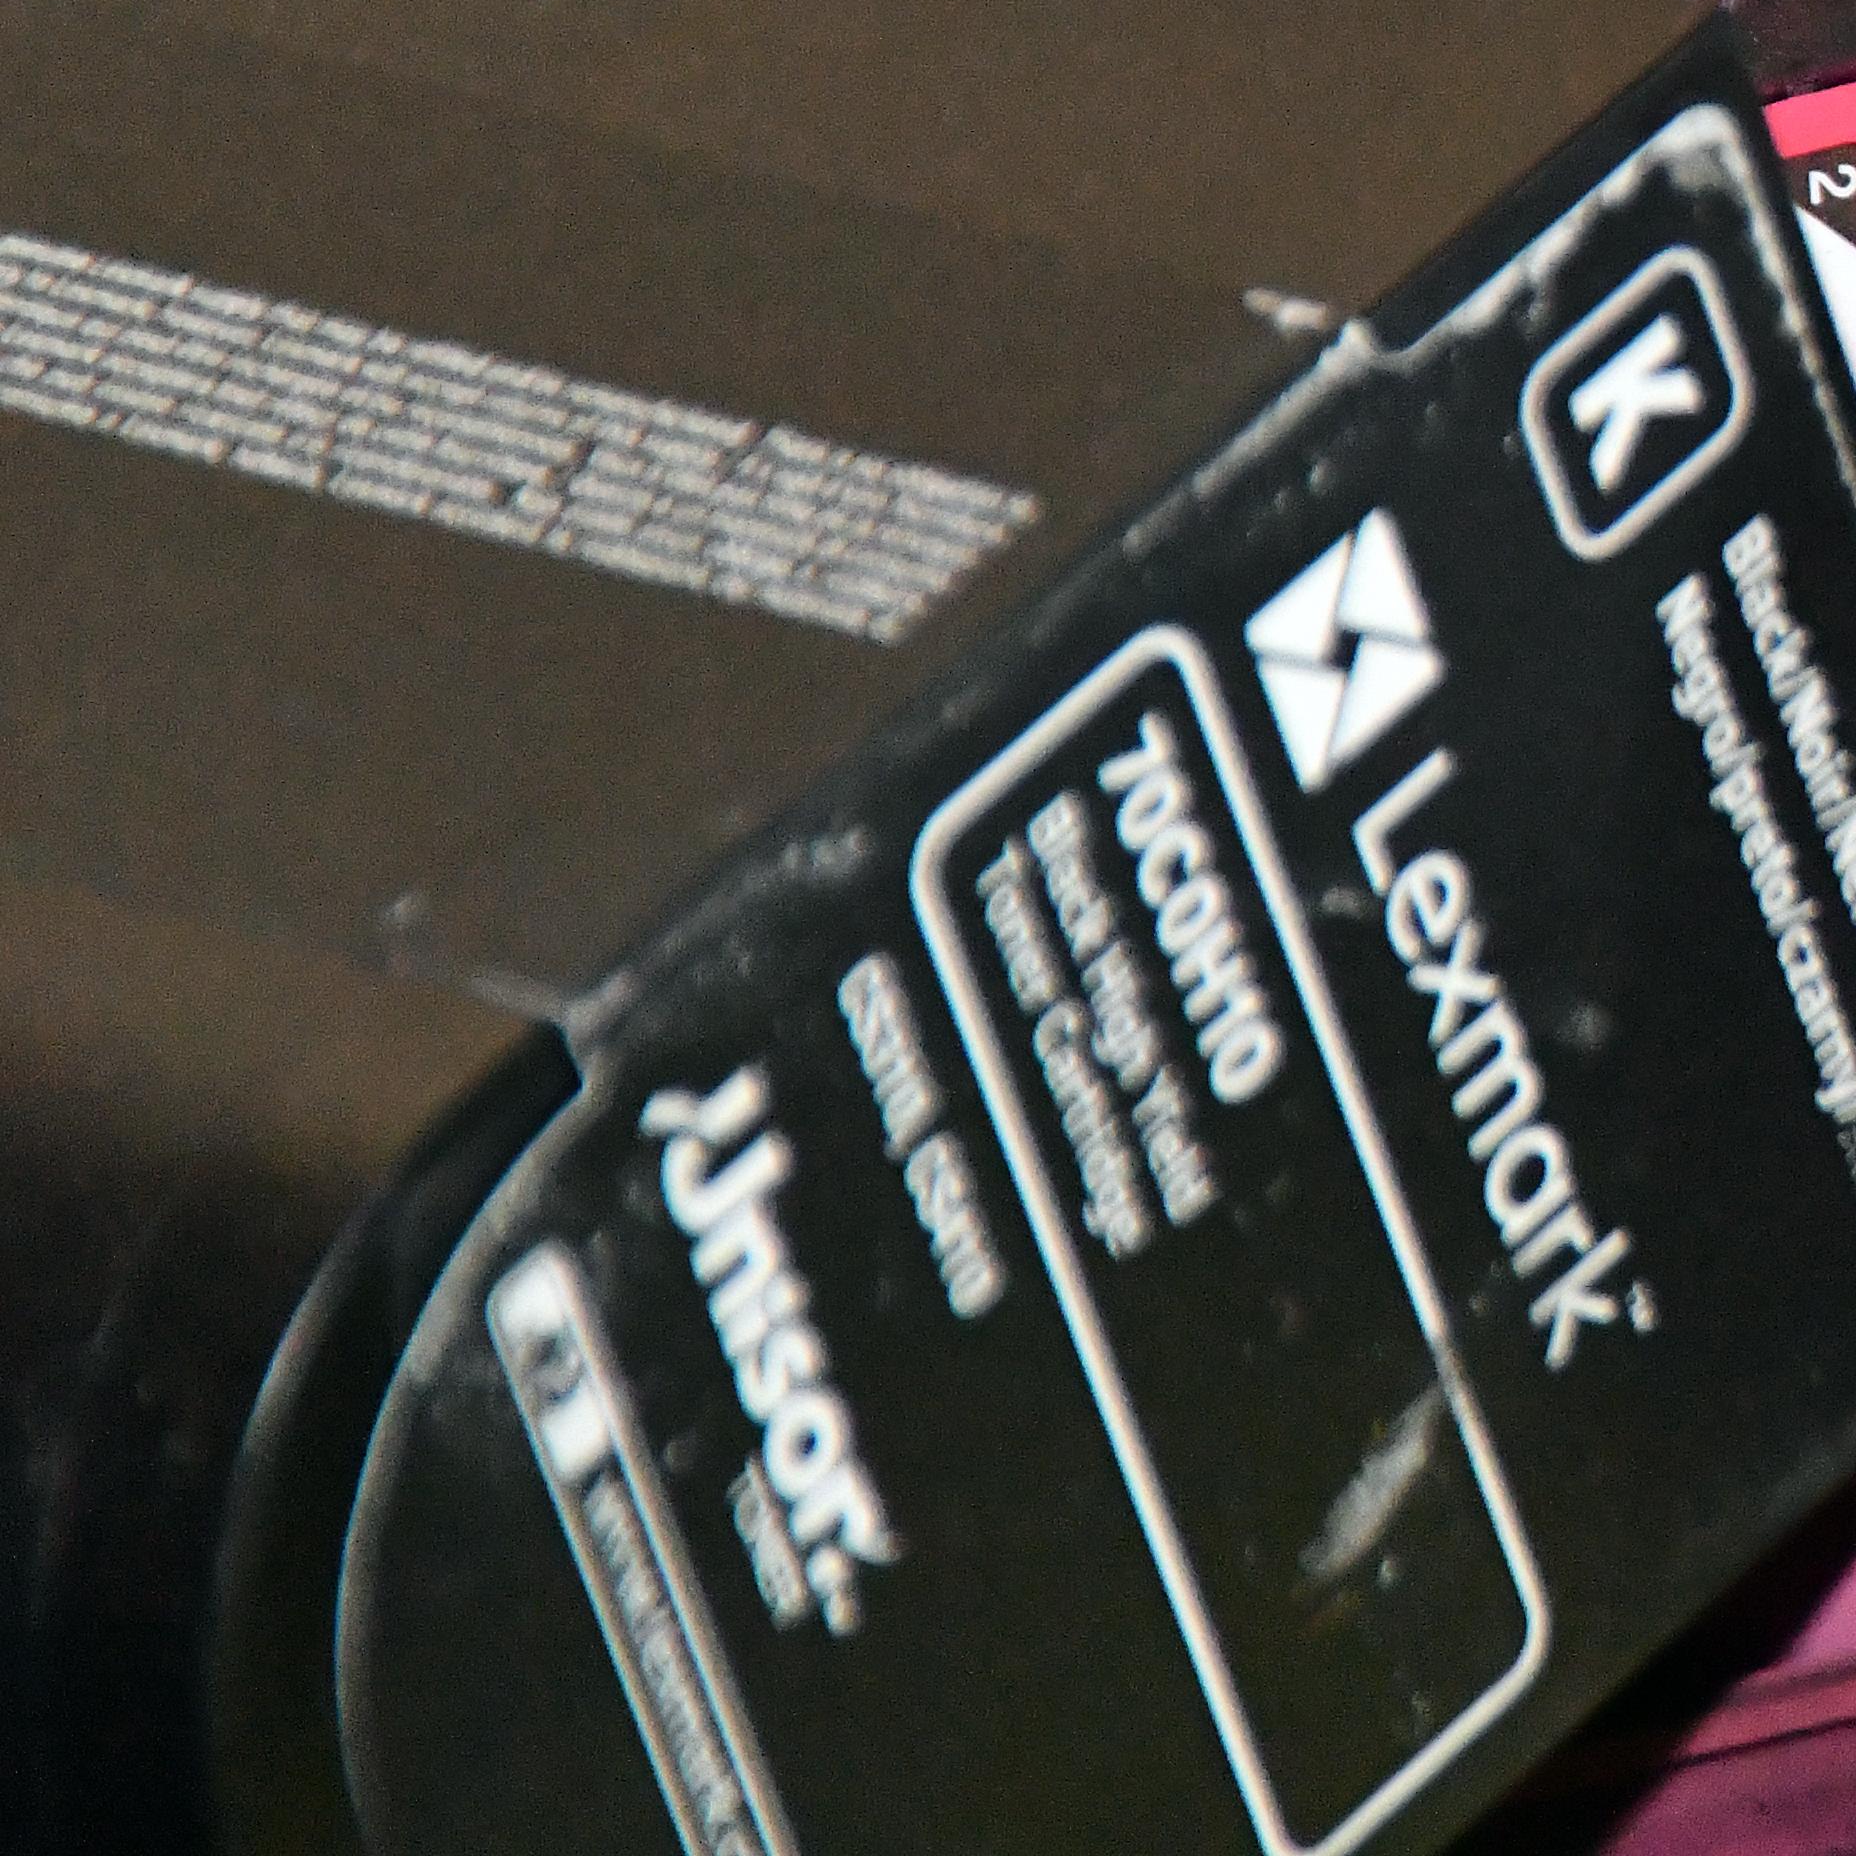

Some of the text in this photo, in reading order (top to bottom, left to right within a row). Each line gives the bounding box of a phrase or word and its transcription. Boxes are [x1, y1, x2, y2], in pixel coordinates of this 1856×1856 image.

[1567, 311, 1706, 491] K
[975, 835, 1153, 1258] Toner Cartridge
[1026, 789, 1219, 1226] Black High Yield
[1097, 710, 1283, 1104] 70C0H10
[1351, 746, 1633, 1371] Lexmark
